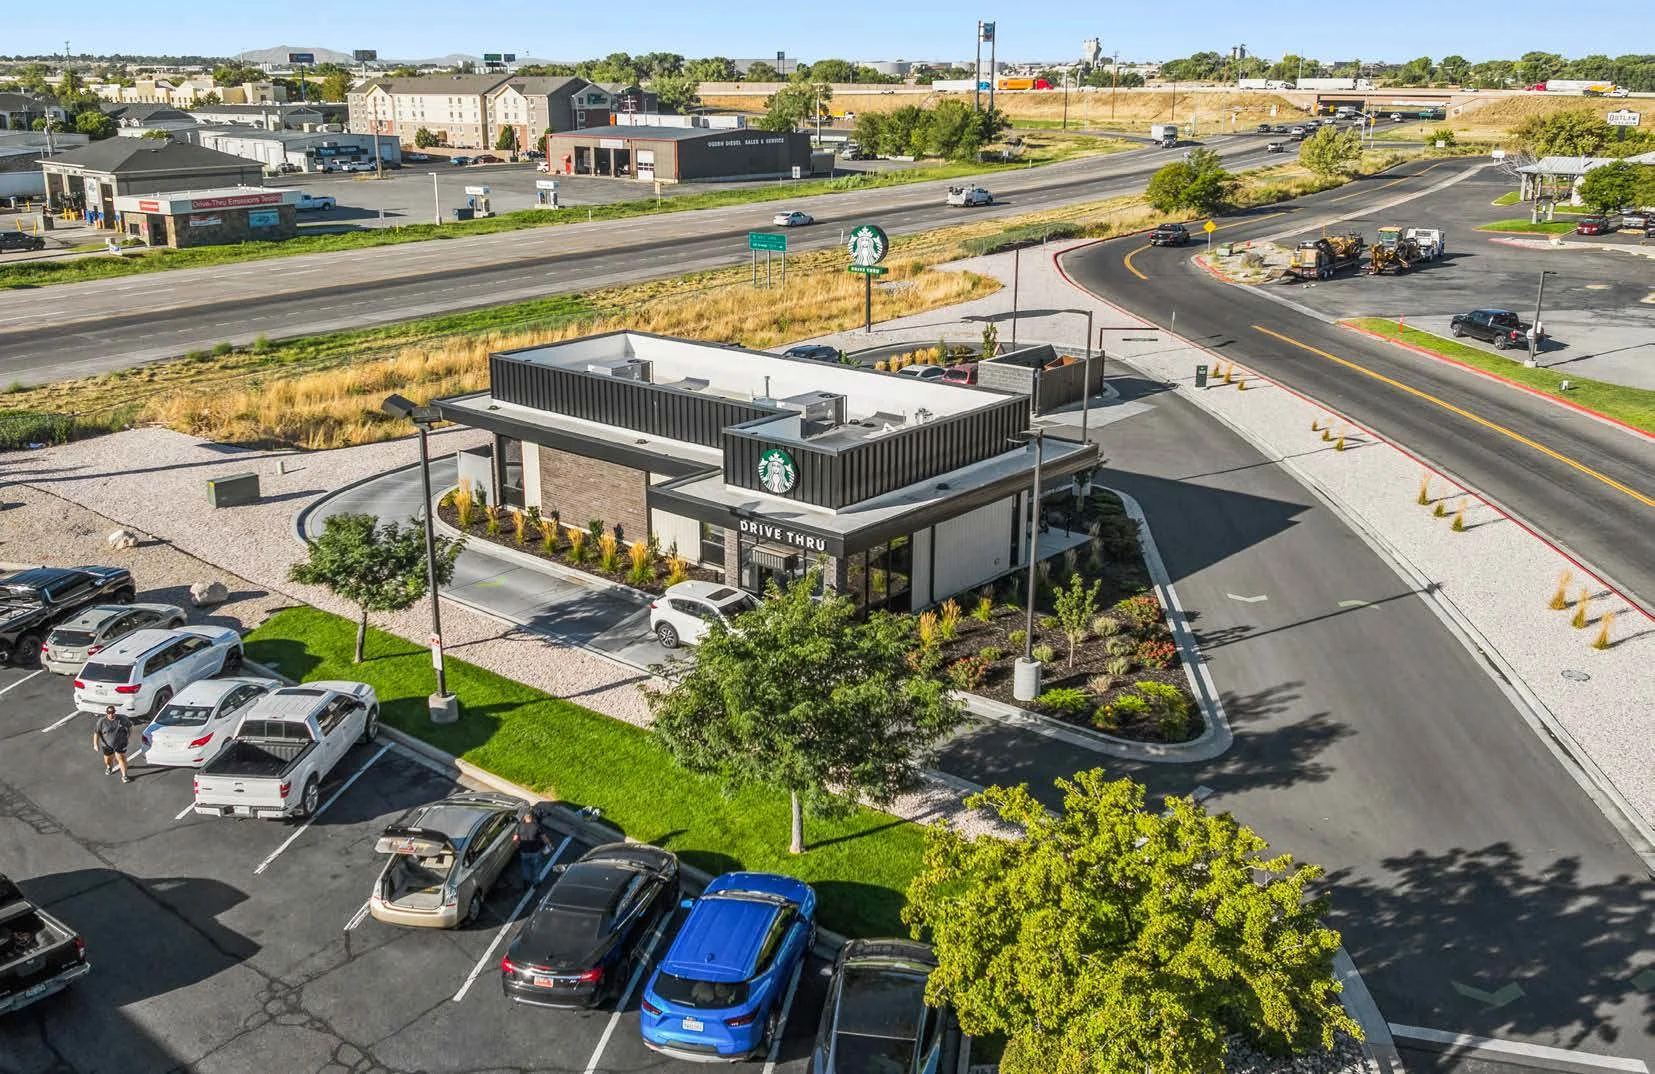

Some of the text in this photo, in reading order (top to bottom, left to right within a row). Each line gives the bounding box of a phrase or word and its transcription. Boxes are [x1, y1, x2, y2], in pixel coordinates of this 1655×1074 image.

[228, 196, 260, 206] Emissions
[740, 519, 826, 551] DRIVE THRU
